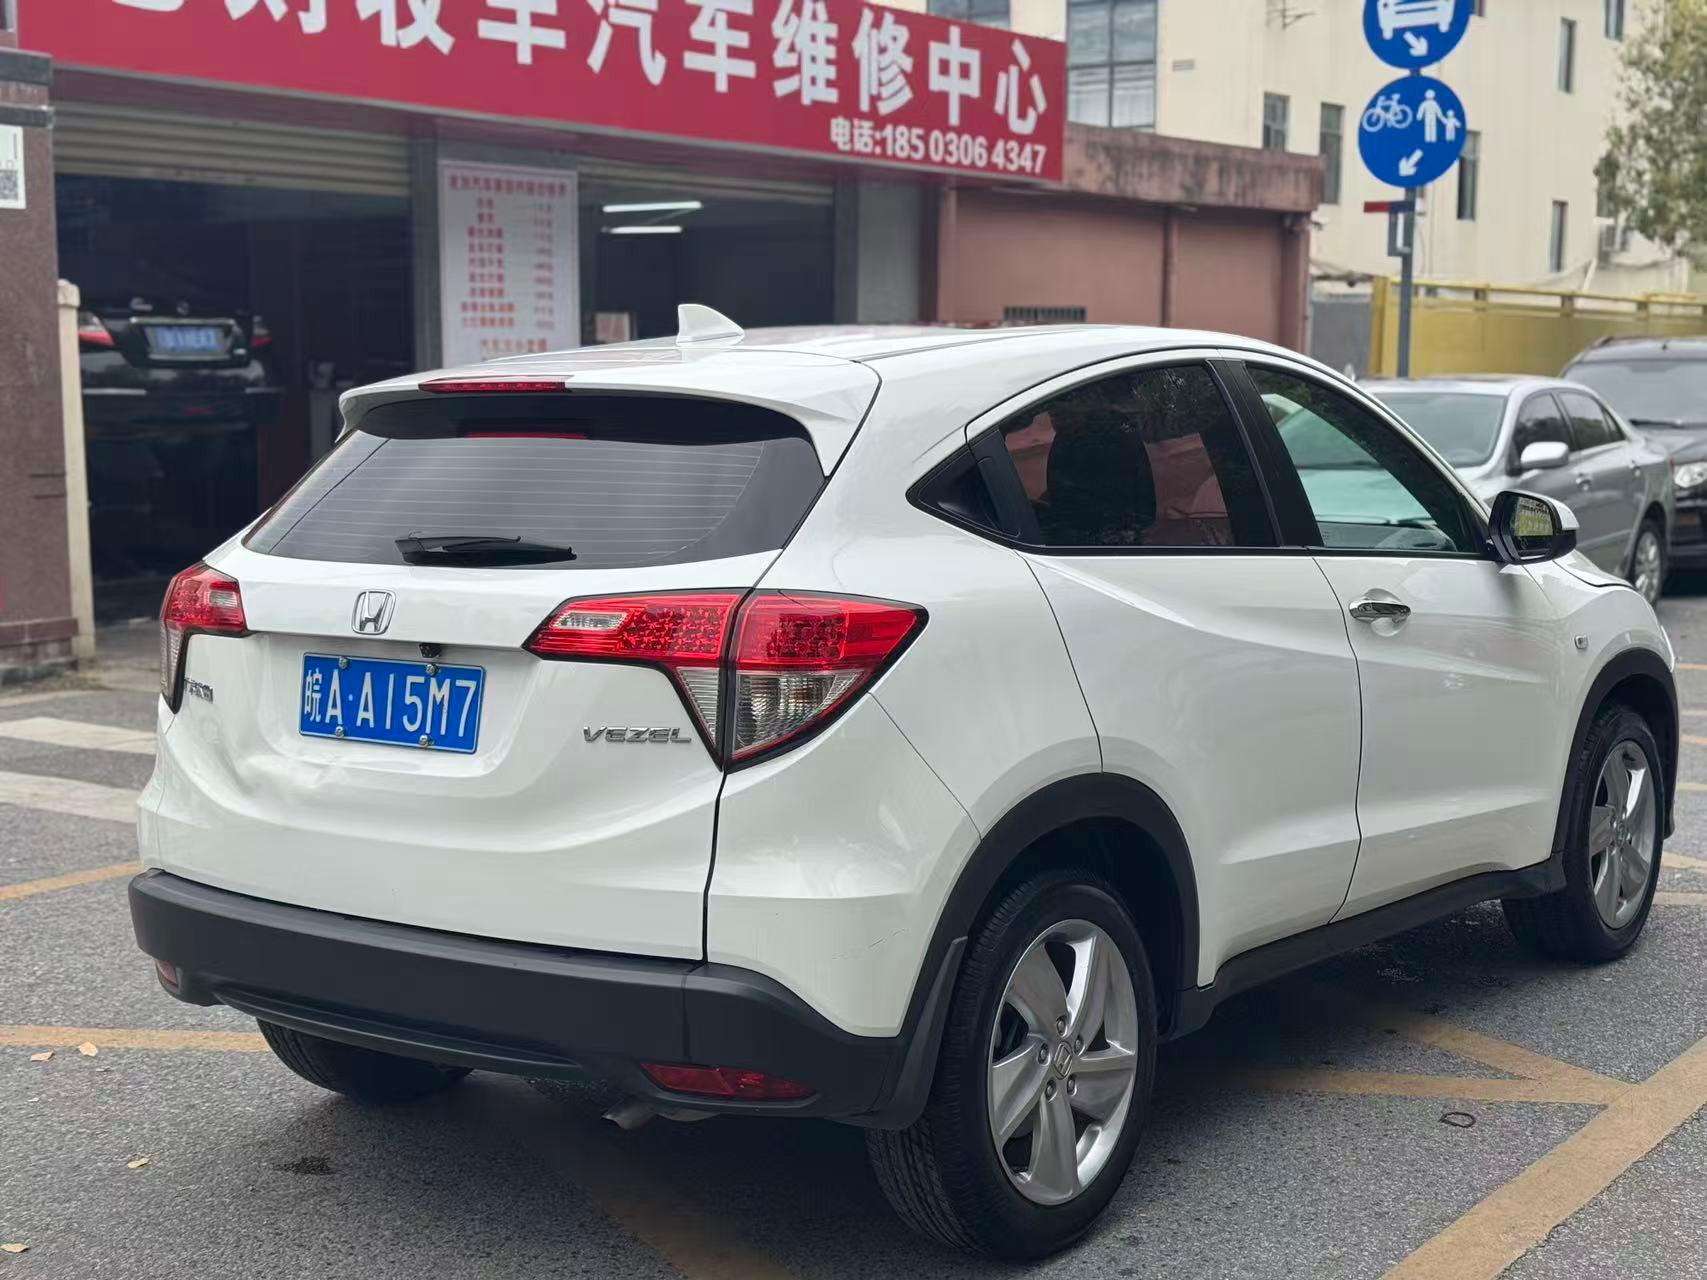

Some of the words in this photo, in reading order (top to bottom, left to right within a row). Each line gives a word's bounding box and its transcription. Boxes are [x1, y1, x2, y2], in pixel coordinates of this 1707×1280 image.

[929, 130, 988, 167] 0306
[991, 138, 1046, 174] 4347
[583, 726, 692, 743] VEZEL
